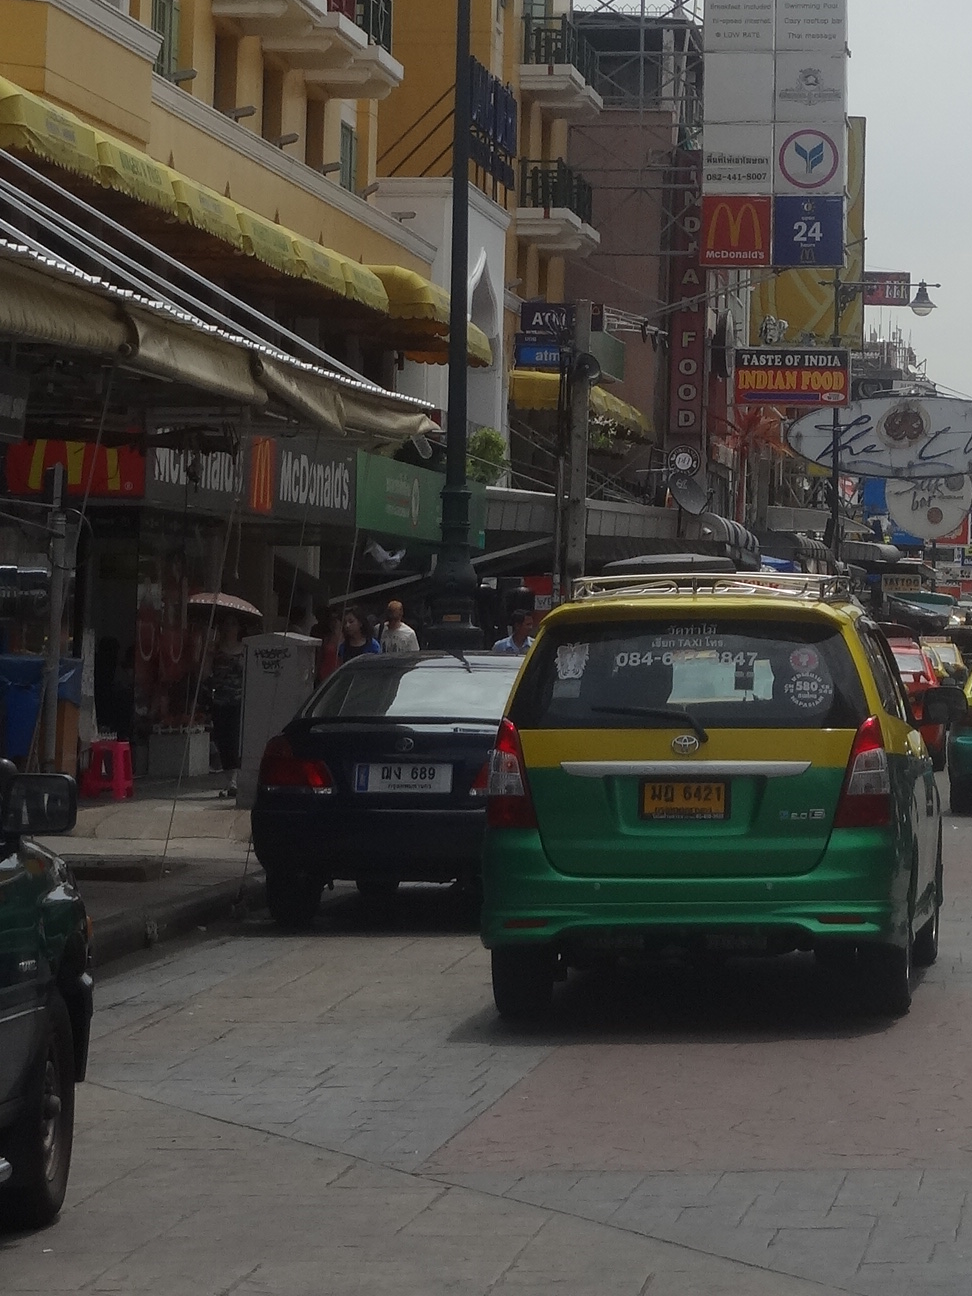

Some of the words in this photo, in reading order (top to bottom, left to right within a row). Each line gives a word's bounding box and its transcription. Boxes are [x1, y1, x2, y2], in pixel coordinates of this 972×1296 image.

[803, 17, 829, 26] rooftop
[831, 17, 843, 25] bar
[787, 32, 802, 40] Thai
[793, 221, 823, 242] 24
[705, 250, 765, 260] McDonald's
[535, 349, 561, 362] atm
[742, 354, 783, 367] TASTE
[785, 354, 801, 367] OF
[803, 354, 841, 367] INDIA
[677, 331, 699, 428] FOOD
[738, 369, 798, 391] INDIAN
[801, 371, 846, 391] FOOD
[814, 414, 886, 462] The
[279, 450, 350, 510] McDonald's
[677, 638, 703, 648] TAXI
[796, 681, 818, 692] 580
[410, 766, 436, 781] 689
[682, 785, 722, 802] 6421
